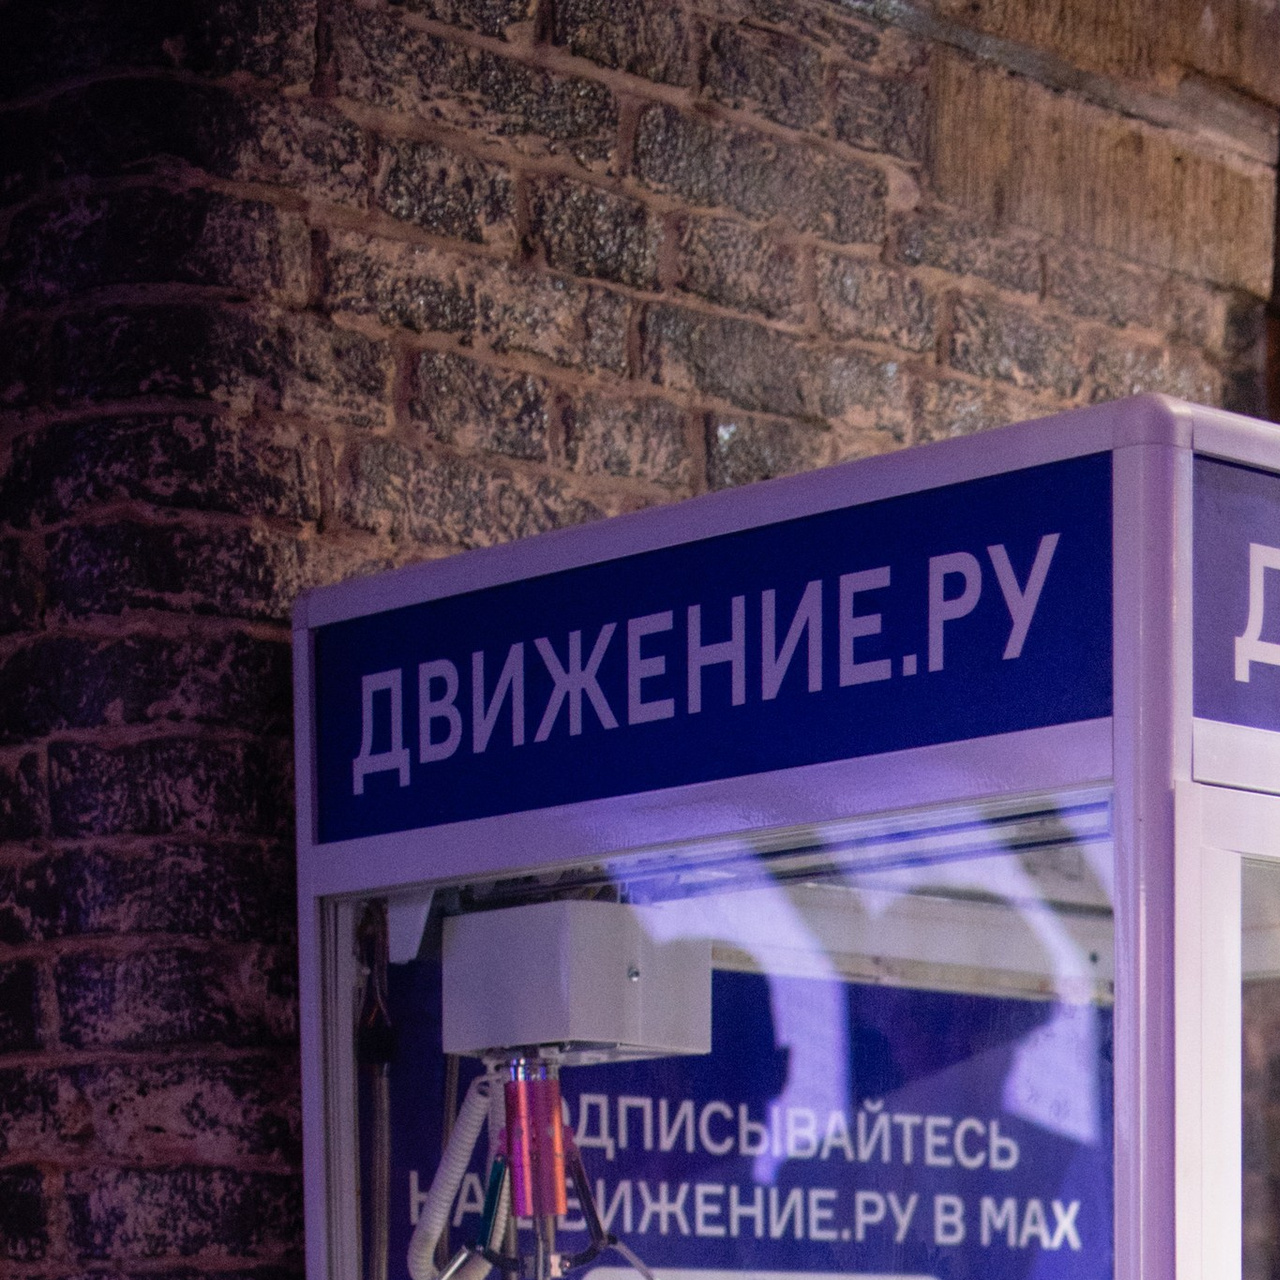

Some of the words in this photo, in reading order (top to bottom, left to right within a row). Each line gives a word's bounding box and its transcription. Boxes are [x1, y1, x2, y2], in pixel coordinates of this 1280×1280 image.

[352, 533, 1061, 795] ДВИЖЕНИЕ.РУ
[497, 1093, 1019, 1170] ДПИСЫВАЙТЕСЬ
[512, 1174, 918, 1244] ИЖЕНИЕ.РУ
[934, 1195, 966, 1246] В
